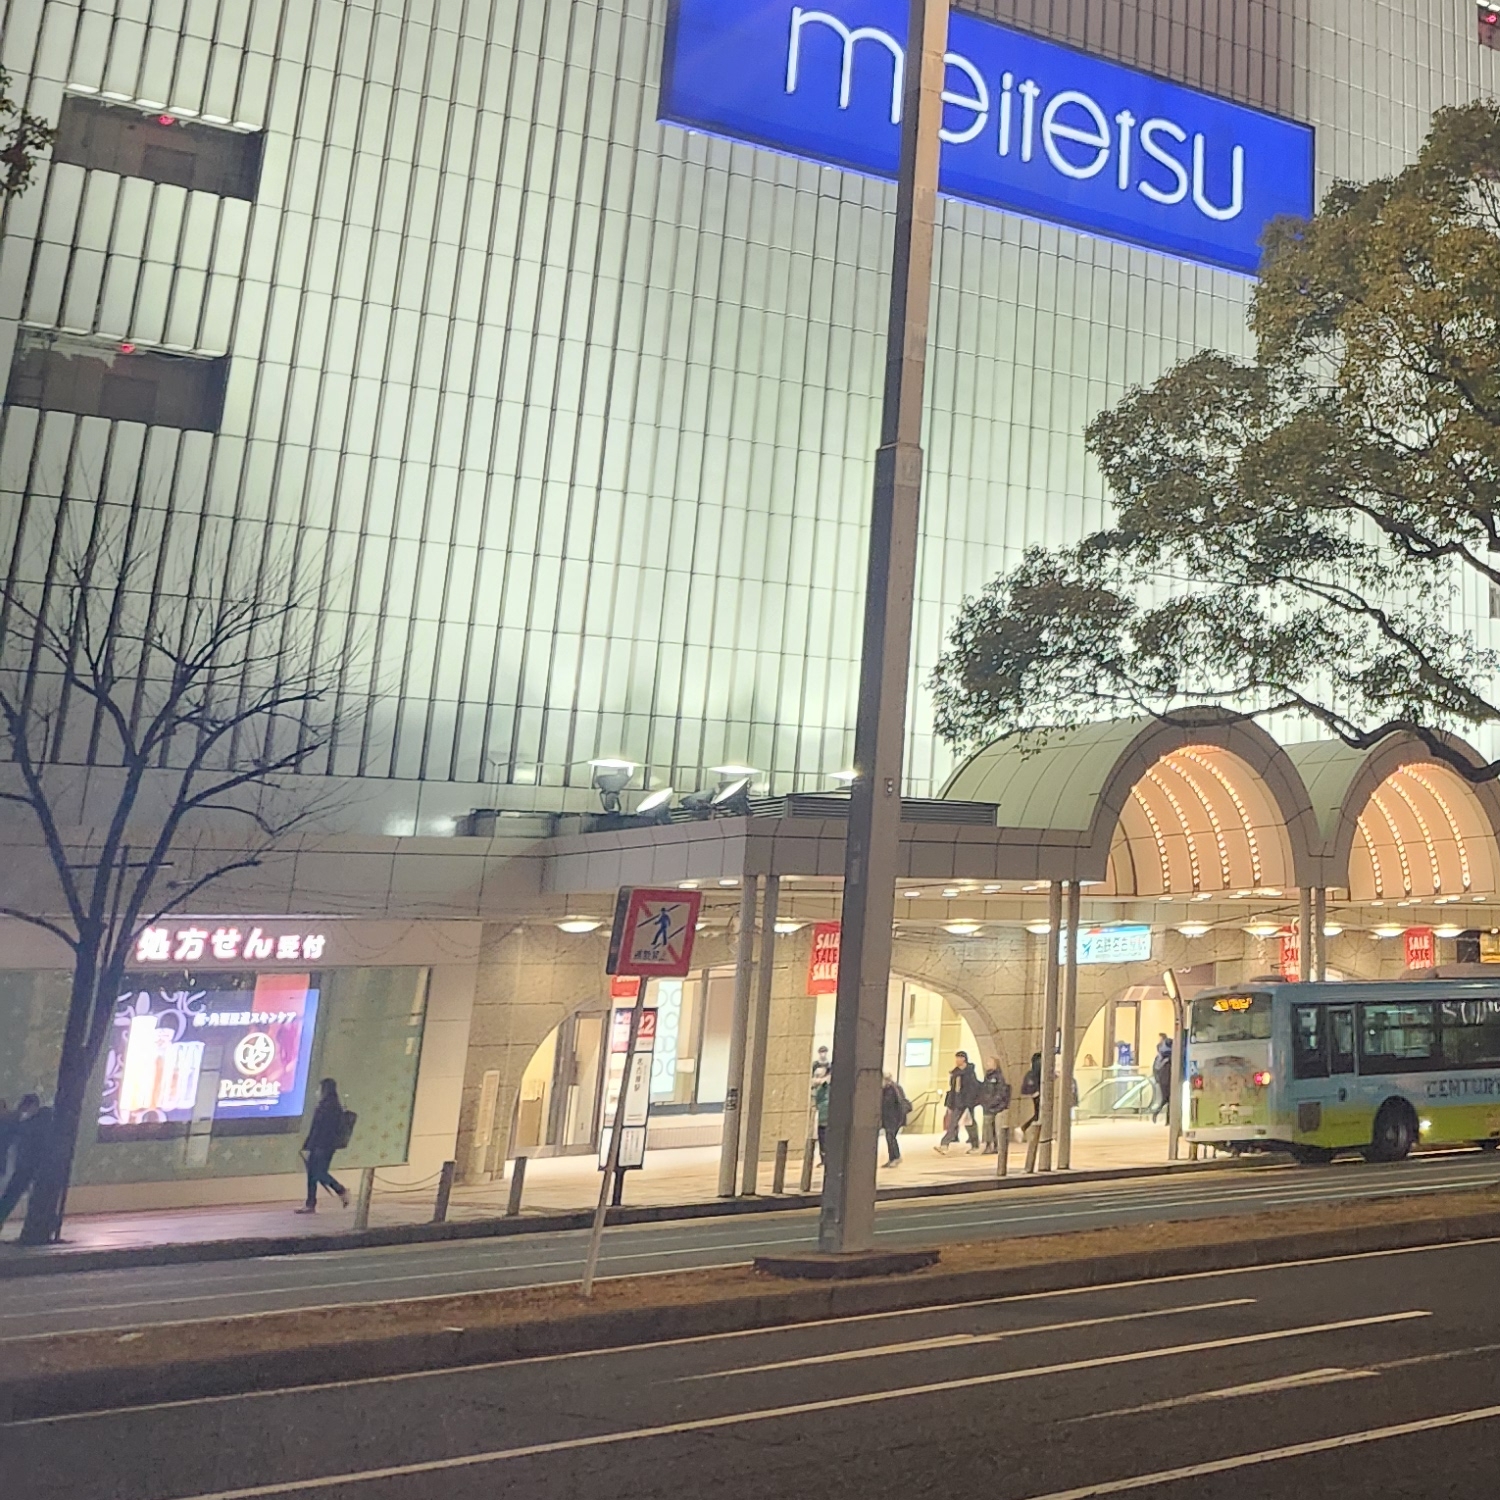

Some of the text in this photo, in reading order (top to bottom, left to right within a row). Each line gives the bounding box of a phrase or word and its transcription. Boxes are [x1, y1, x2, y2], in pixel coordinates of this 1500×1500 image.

[786, 6, 1244, 221] meitetsu
[1408, 935, 1430, 950] SALE
[1409, 949, 1430, 962] SALE
